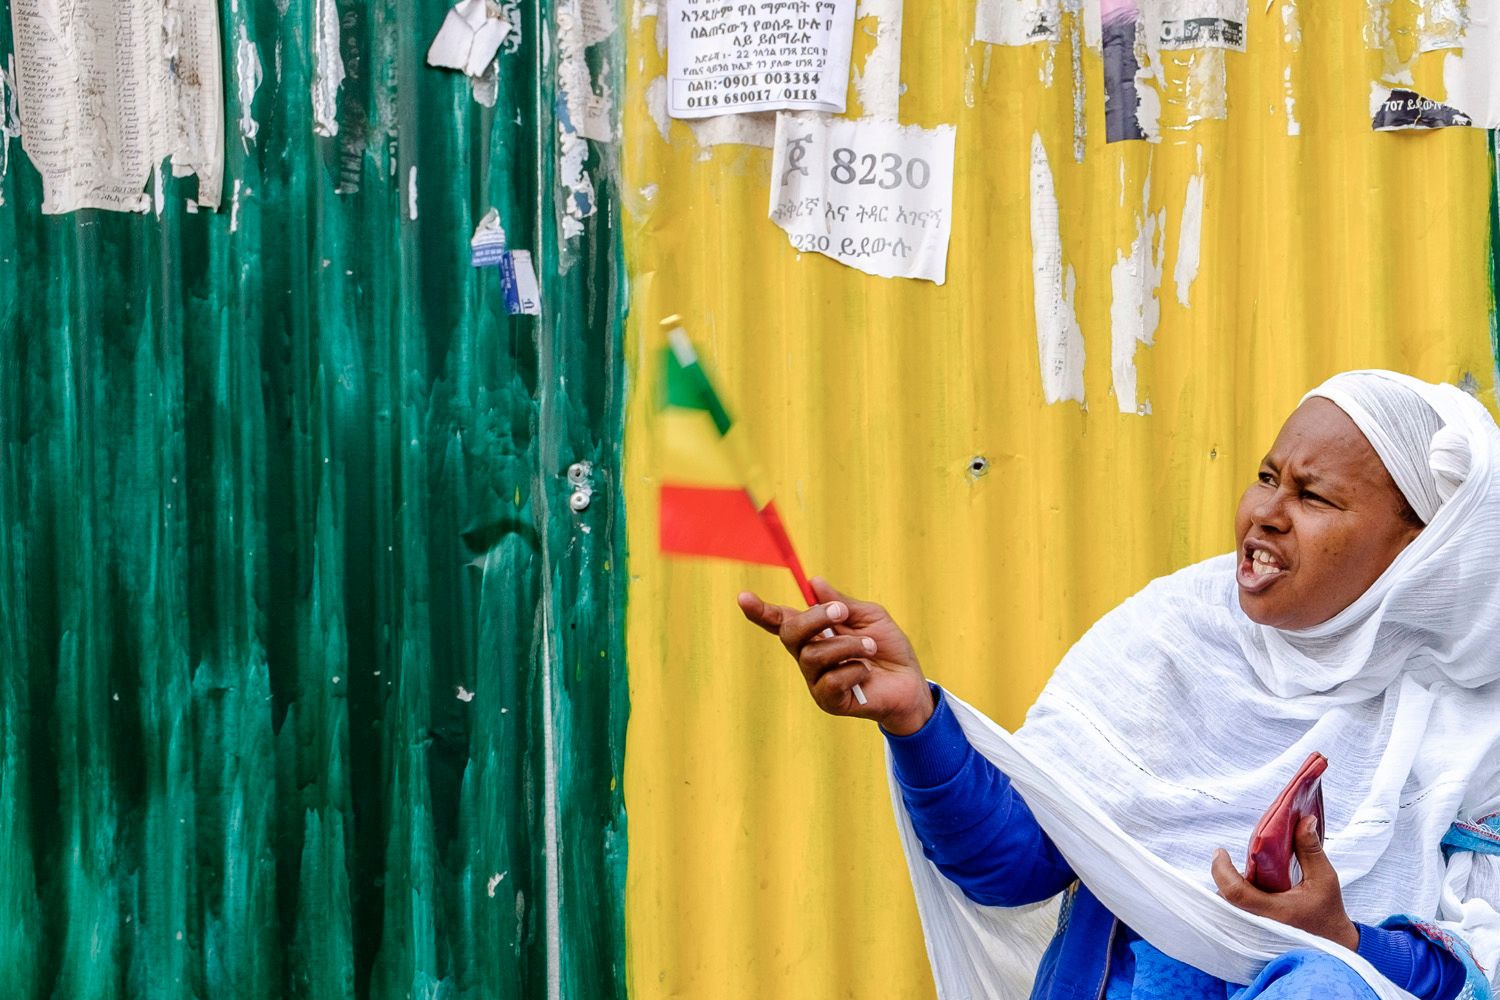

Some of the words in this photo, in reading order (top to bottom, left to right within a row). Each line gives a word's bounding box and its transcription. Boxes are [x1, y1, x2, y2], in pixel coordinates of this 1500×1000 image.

[736, 49, 750, 59] 22
[764, 71, 820, 85] 003384
[687, 94, 718, 108] 0118
[723, 89, 771, 105] 680017
[830, 147, 931, 190] 8230
[788, 233, 830, 252] 230
